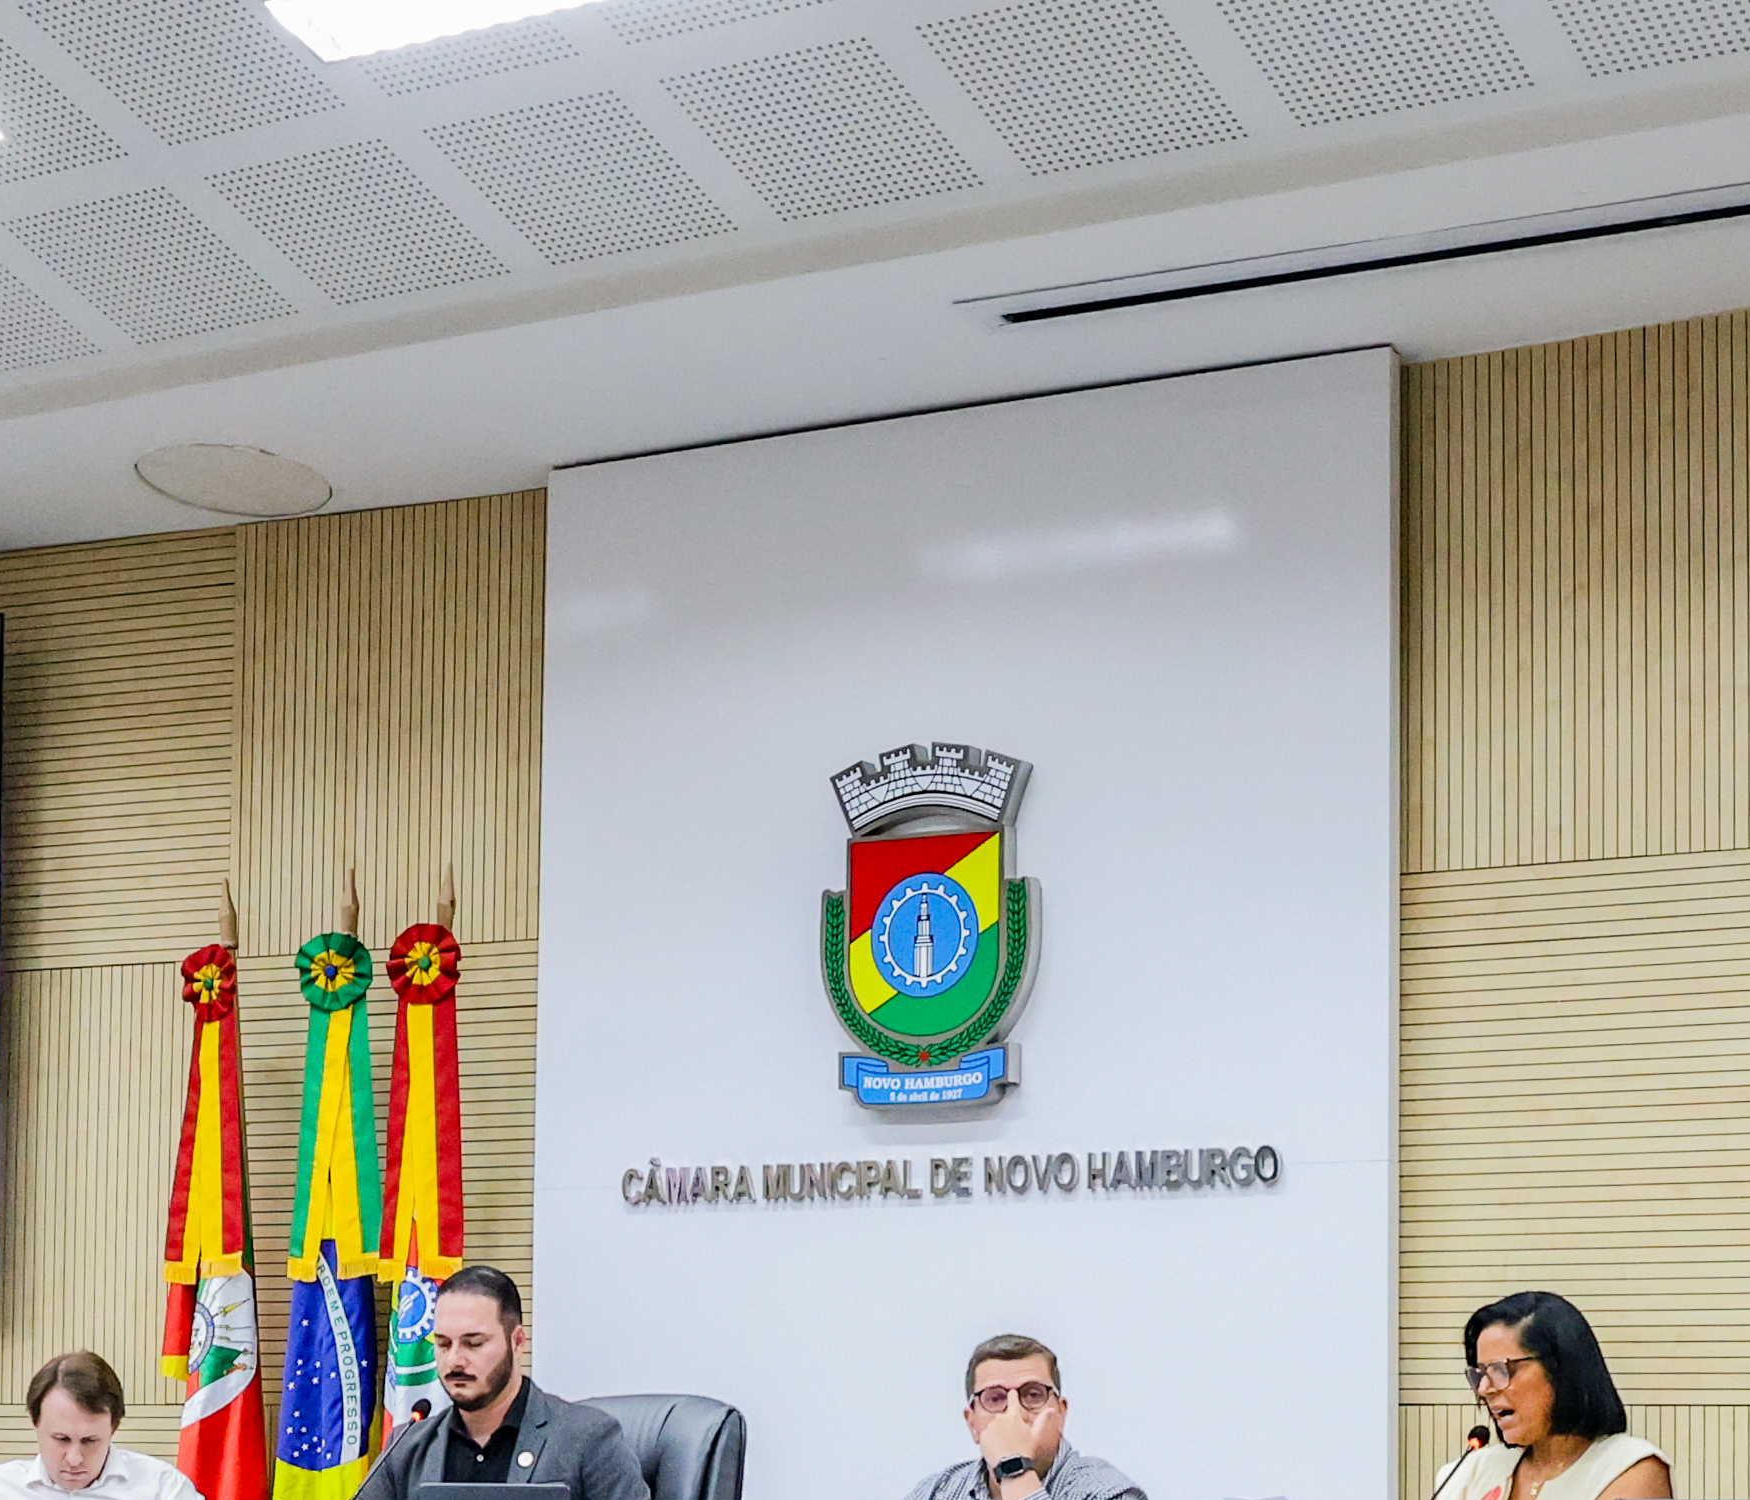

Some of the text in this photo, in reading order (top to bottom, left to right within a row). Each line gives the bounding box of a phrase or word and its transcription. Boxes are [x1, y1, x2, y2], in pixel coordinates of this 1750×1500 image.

[863, 1072, 983, 1090] NOVO HAMBURGO
[942, 1089, 963, 1099] 1927
[622, 1145, 1283, 1206] CÂMARA MUNICIPAL DE NOVO HAMBURGO
[317, 1264, 340, 1312] RDEM
[337, 1330, 358, 1446] PROGRESSO
